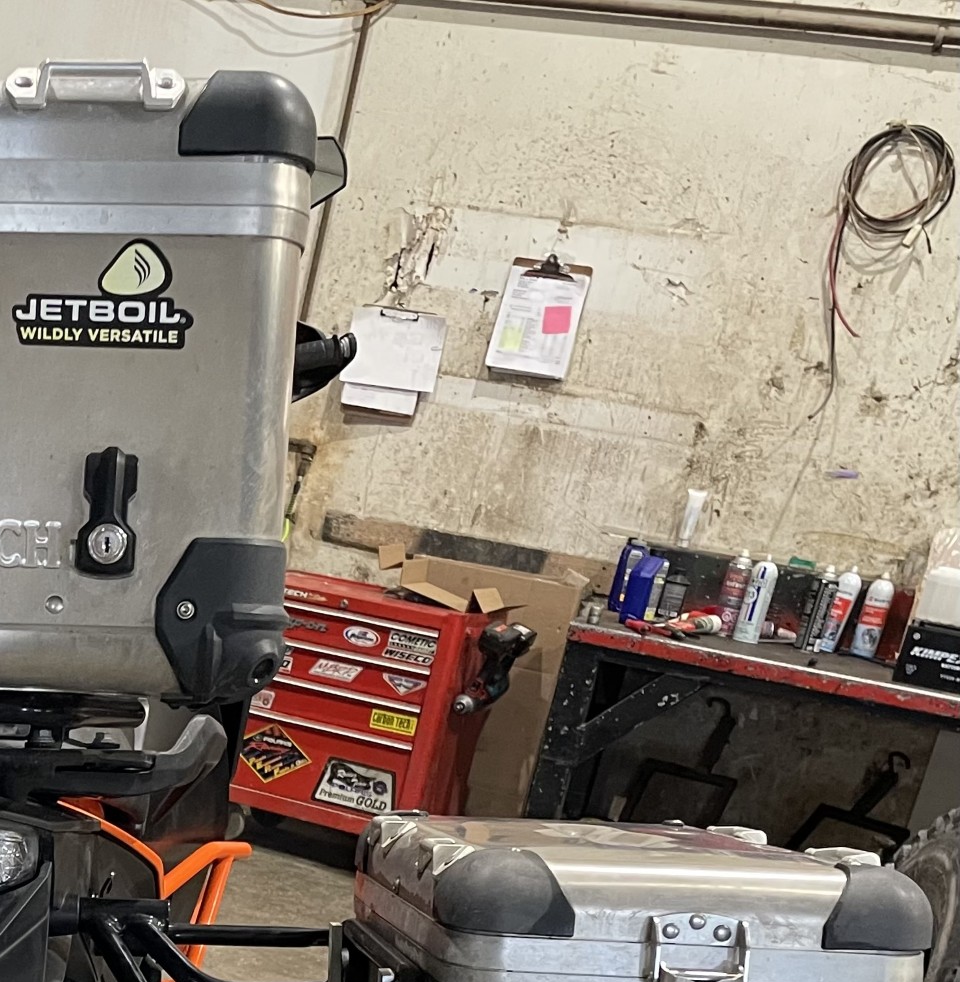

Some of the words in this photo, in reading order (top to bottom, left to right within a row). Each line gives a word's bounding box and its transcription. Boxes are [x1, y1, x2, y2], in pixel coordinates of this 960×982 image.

[16, 299, 181, 324] JETBOIL
[20, 327, 83, 341] WILDLY
[88, 329, 178, 343] VERSATILE
[390, 633, 437, 648] COMETIC
[384, 648, 432, 664] WISECO
[319, 788, 355, 804] Premium
[356, 795, 387, 811] GOLD
